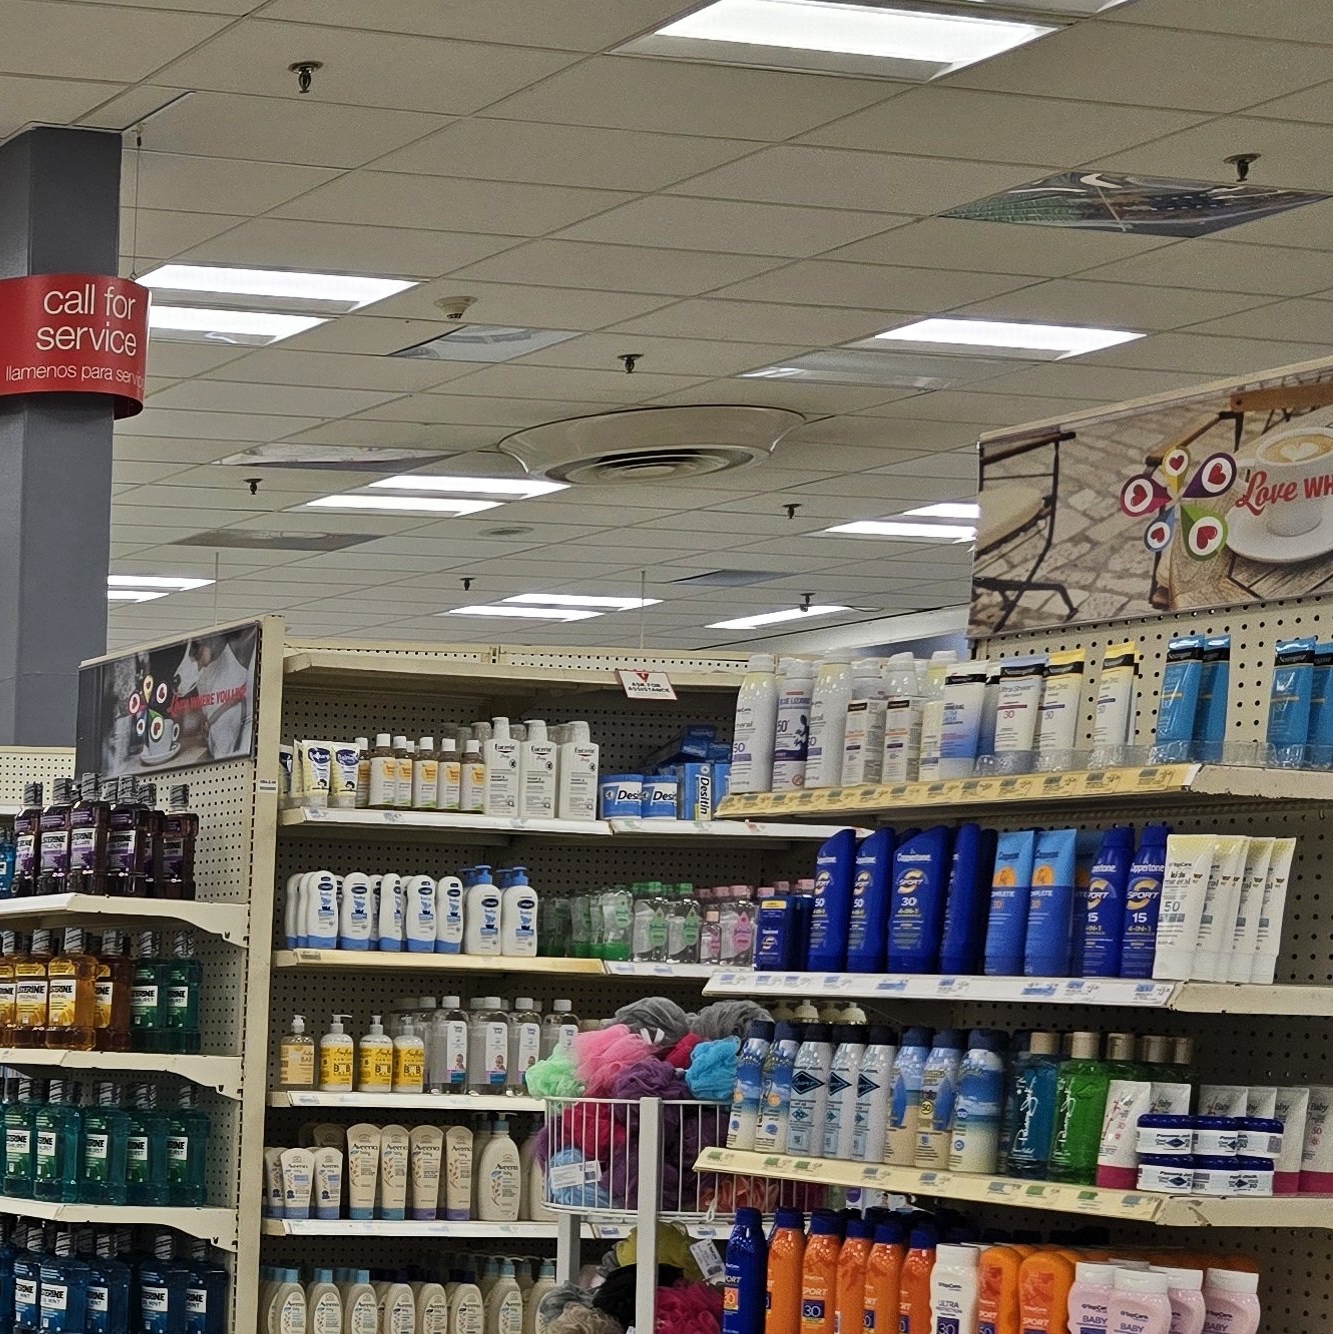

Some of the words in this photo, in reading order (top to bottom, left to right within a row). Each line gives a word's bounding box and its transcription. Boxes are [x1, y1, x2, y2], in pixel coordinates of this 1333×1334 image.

[43, 283, 96, 316] call
[104, 285, 136, 321] for
[35, 321, 137, 358] service
[5, 363, 77, 382] llamenos
[81, 364, 113, 383] para
[1234, 470, 1298, 517] Love
[627, 686, 671, 694] ASSISTANCE
[191, 692, 216, 709] WHERE
[215, 690, 233, 704] YOU
[493, 743, 517, 752] Eucerin
[530, 744, 553, 754] Eucerin
[573, 746, 596, 755] Eucerin
[698, 777, 711, 815] Desitin
[1126, 889, 1161, 901] SPORT
[900, 896, 918, 907] 30
[1163, 900, 1181, 913] 50
[1132, 911, 1148, 923] 15
[1158, 1099, 1173, 1109] Baby
[1214, 1102, 1230, 1113] Baby
[1310, 1100, 1330, 1112] Baby
[351, 1143, 379, 1152] Aveeno
[385, 1143, 409, 1152] Aveeno
[413, 1144, 441, 1153] Aveeno
[450, 1145, 473, 1153] Aveeno
[286, 1162, 309, 1171] Aveeno
[320, 1162, 340, 1171] Aveeno
[494, 1163, 519, 1172] Aveeno
[802, 1286, 829, 1297] SPORT
[936, 1299, 960, 1310] ULTRA
[803, 1304, 822, 1318] 30
[1021, 1317, 1050, 1327] SPORT
[1082, 1315, 1109, 1325] BABY
[1119, 1321, 1145, 1333] BABY
[1203, 1321, 1229, 1332] BABY
